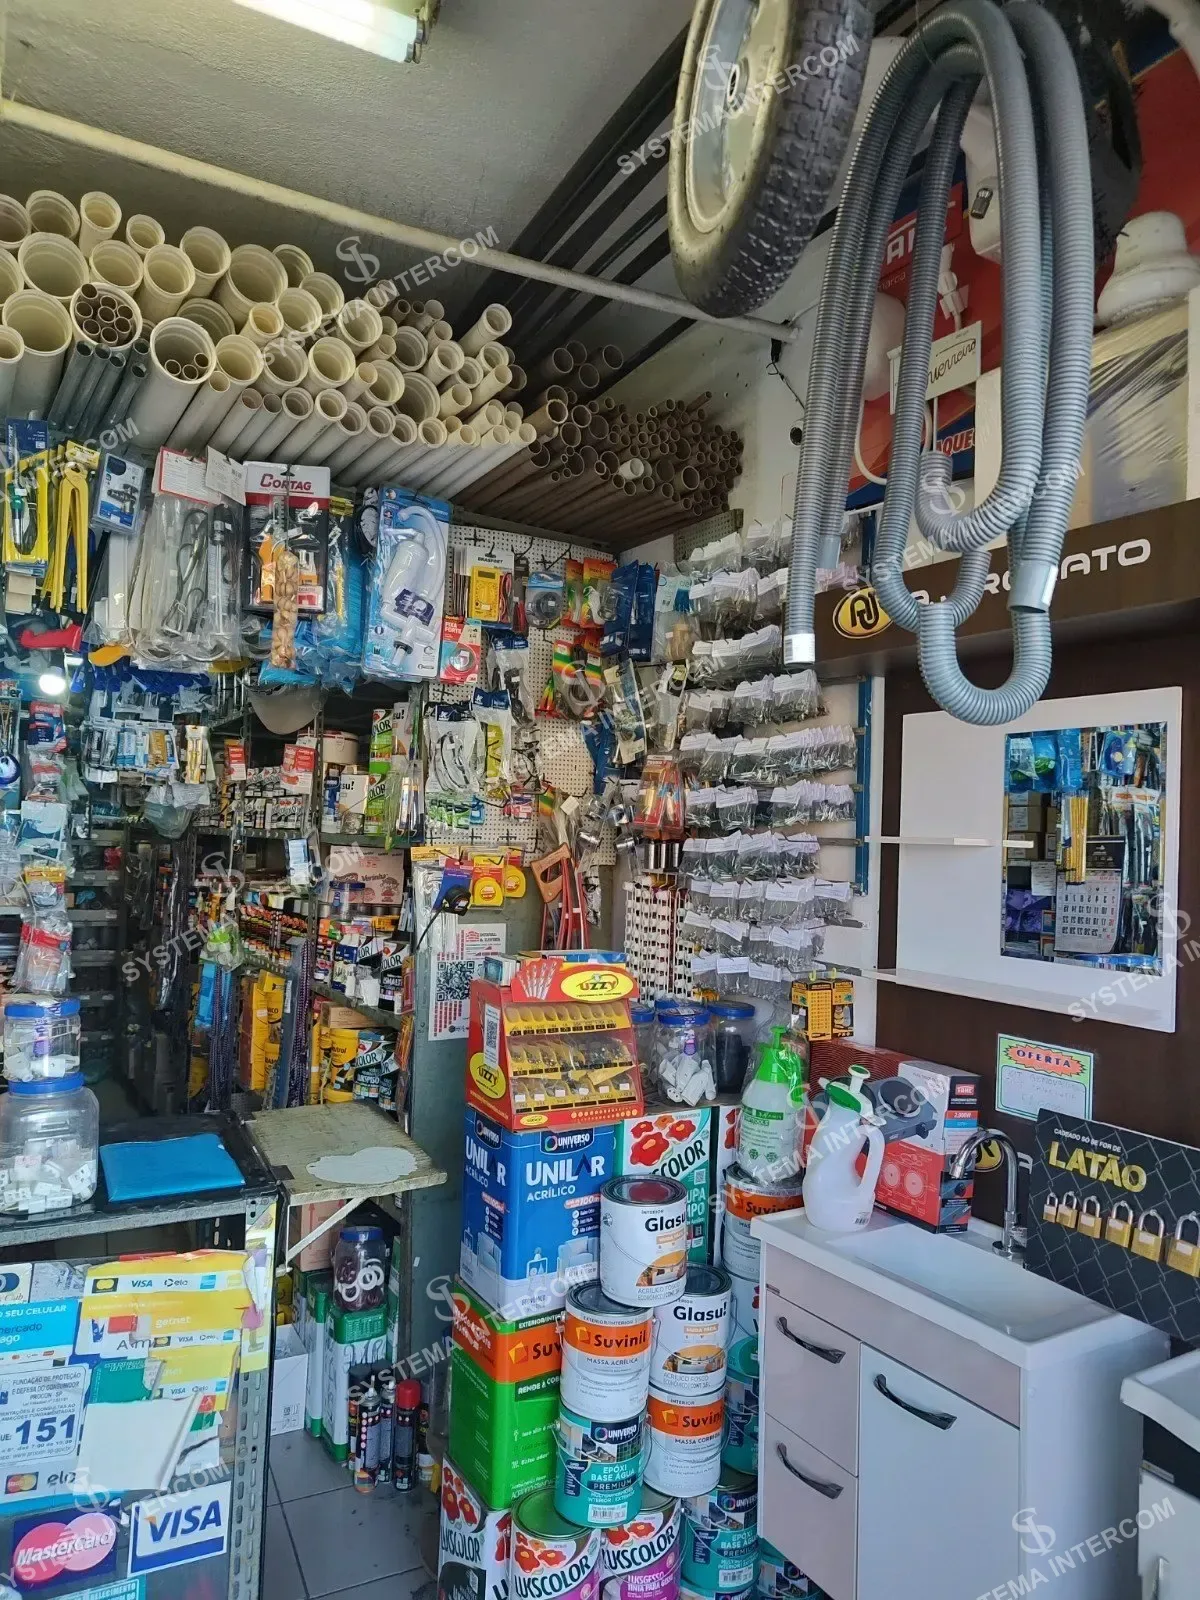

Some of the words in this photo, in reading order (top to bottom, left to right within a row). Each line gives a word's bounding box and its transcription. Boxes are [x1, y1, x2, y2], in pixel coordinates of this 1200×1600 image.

[259, 473, 313, 492] CORTAG
[1016, 1048, 1072, 1069] OFERTA
[557, 1133, 590, 1148] UNIVERSO
[1053, 1127, 1081, 1141] CADEADO
[1112, 1143, 1122, 1153] DE
[1048, 1140, 1147, 1193] LATÃO
[526, 1184, 576, 1203] ACRÍLICO
[644, 1211, 686, 1232] Glasu
[131, 1278, 153, 1288] VISA
[5, 1306, 24, 1317] SEU
[26, 1304, 67, 1316] CELULAR
[673, 1301, 727, 1322] Glasu!
[0, 1334, 20, 1347] ago
[594, 1329, 646, 1348] Suvinil
[586, 1357, 610, 1366] MASSA
[611, 1357, 639, 1366] ACRÍLICA
[682, 1409, 724, 1428] Suvini
[15, 1413, 76, 1445] 151
[608, 1424, 637, 1439] UNIVERSO
[674, 1437, 695, 1446] MASSA
[47, 1470, 76, 1486] elo
[590, 1473, 613, 1482] BASE
[603, 1464, 627, 1474] EPÓXI
[593, 1478, 632, 1490] PREMIUM
[149, 1500, 222, 1542] VISA
[17, 1528, 114, 1567] MasterCard
[602, 1525, 675, 1570] LUKSCOLOR
[515, 1553, 591, 1600] LUKSCOLOR
